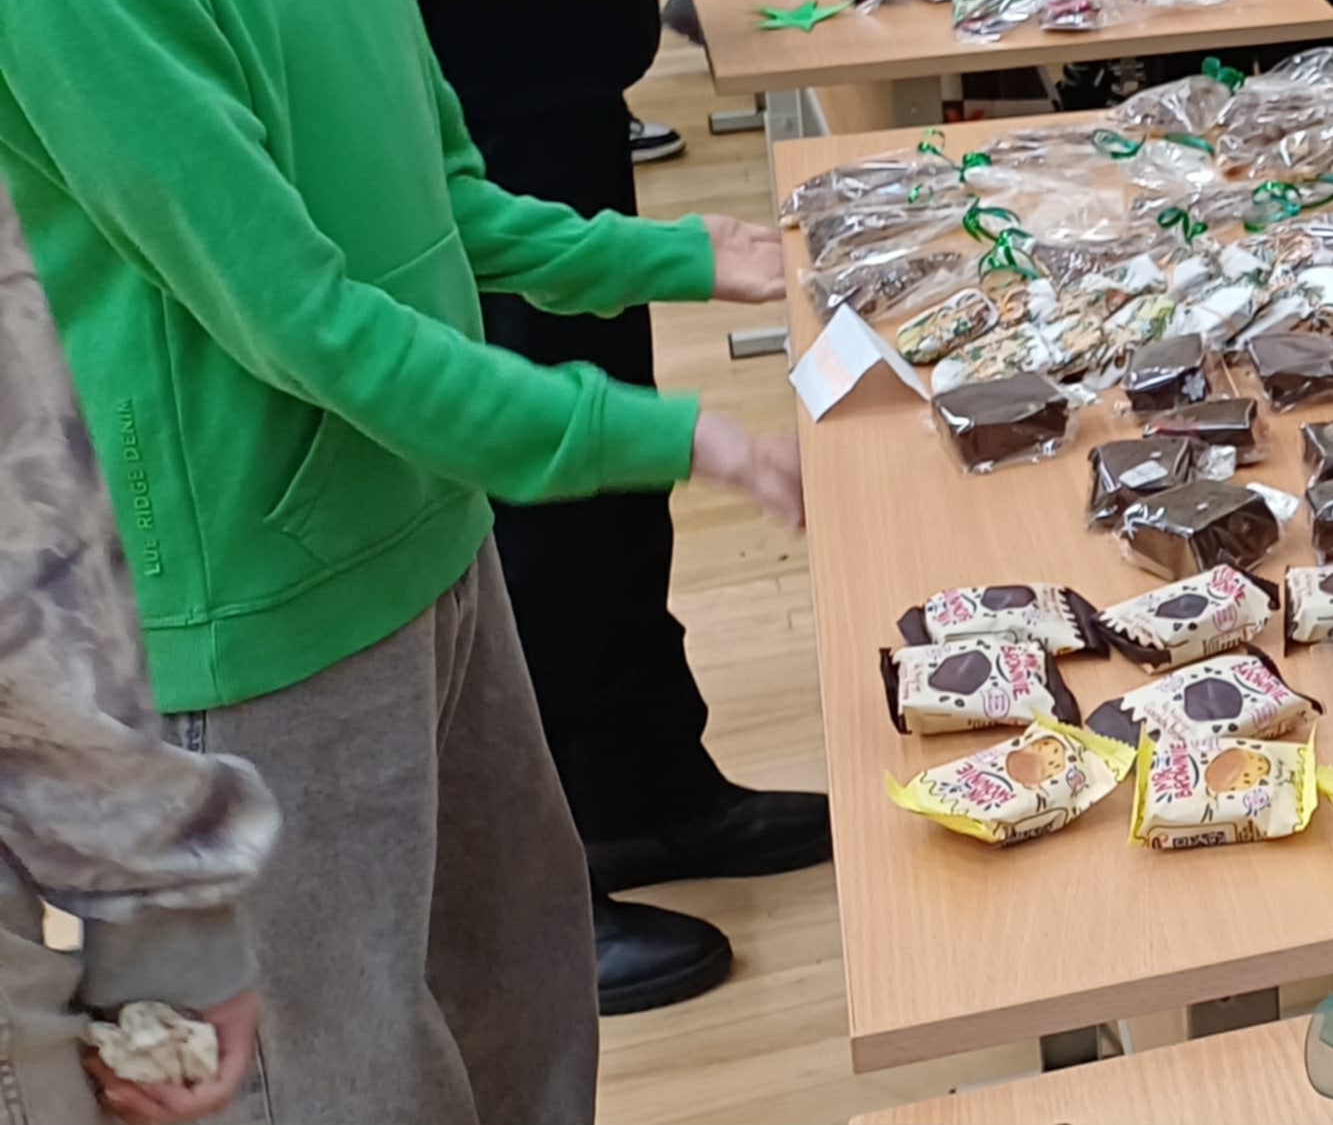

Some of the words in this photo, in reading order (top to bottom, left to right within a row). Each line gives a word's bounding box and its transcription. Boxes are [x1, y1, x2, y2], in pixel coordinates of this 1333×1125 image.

[115, 397, 142, 461] DENIM
[128, 469, 155, 531] RIDGE
[1169, 742, 1193, 800] BROWNIE
